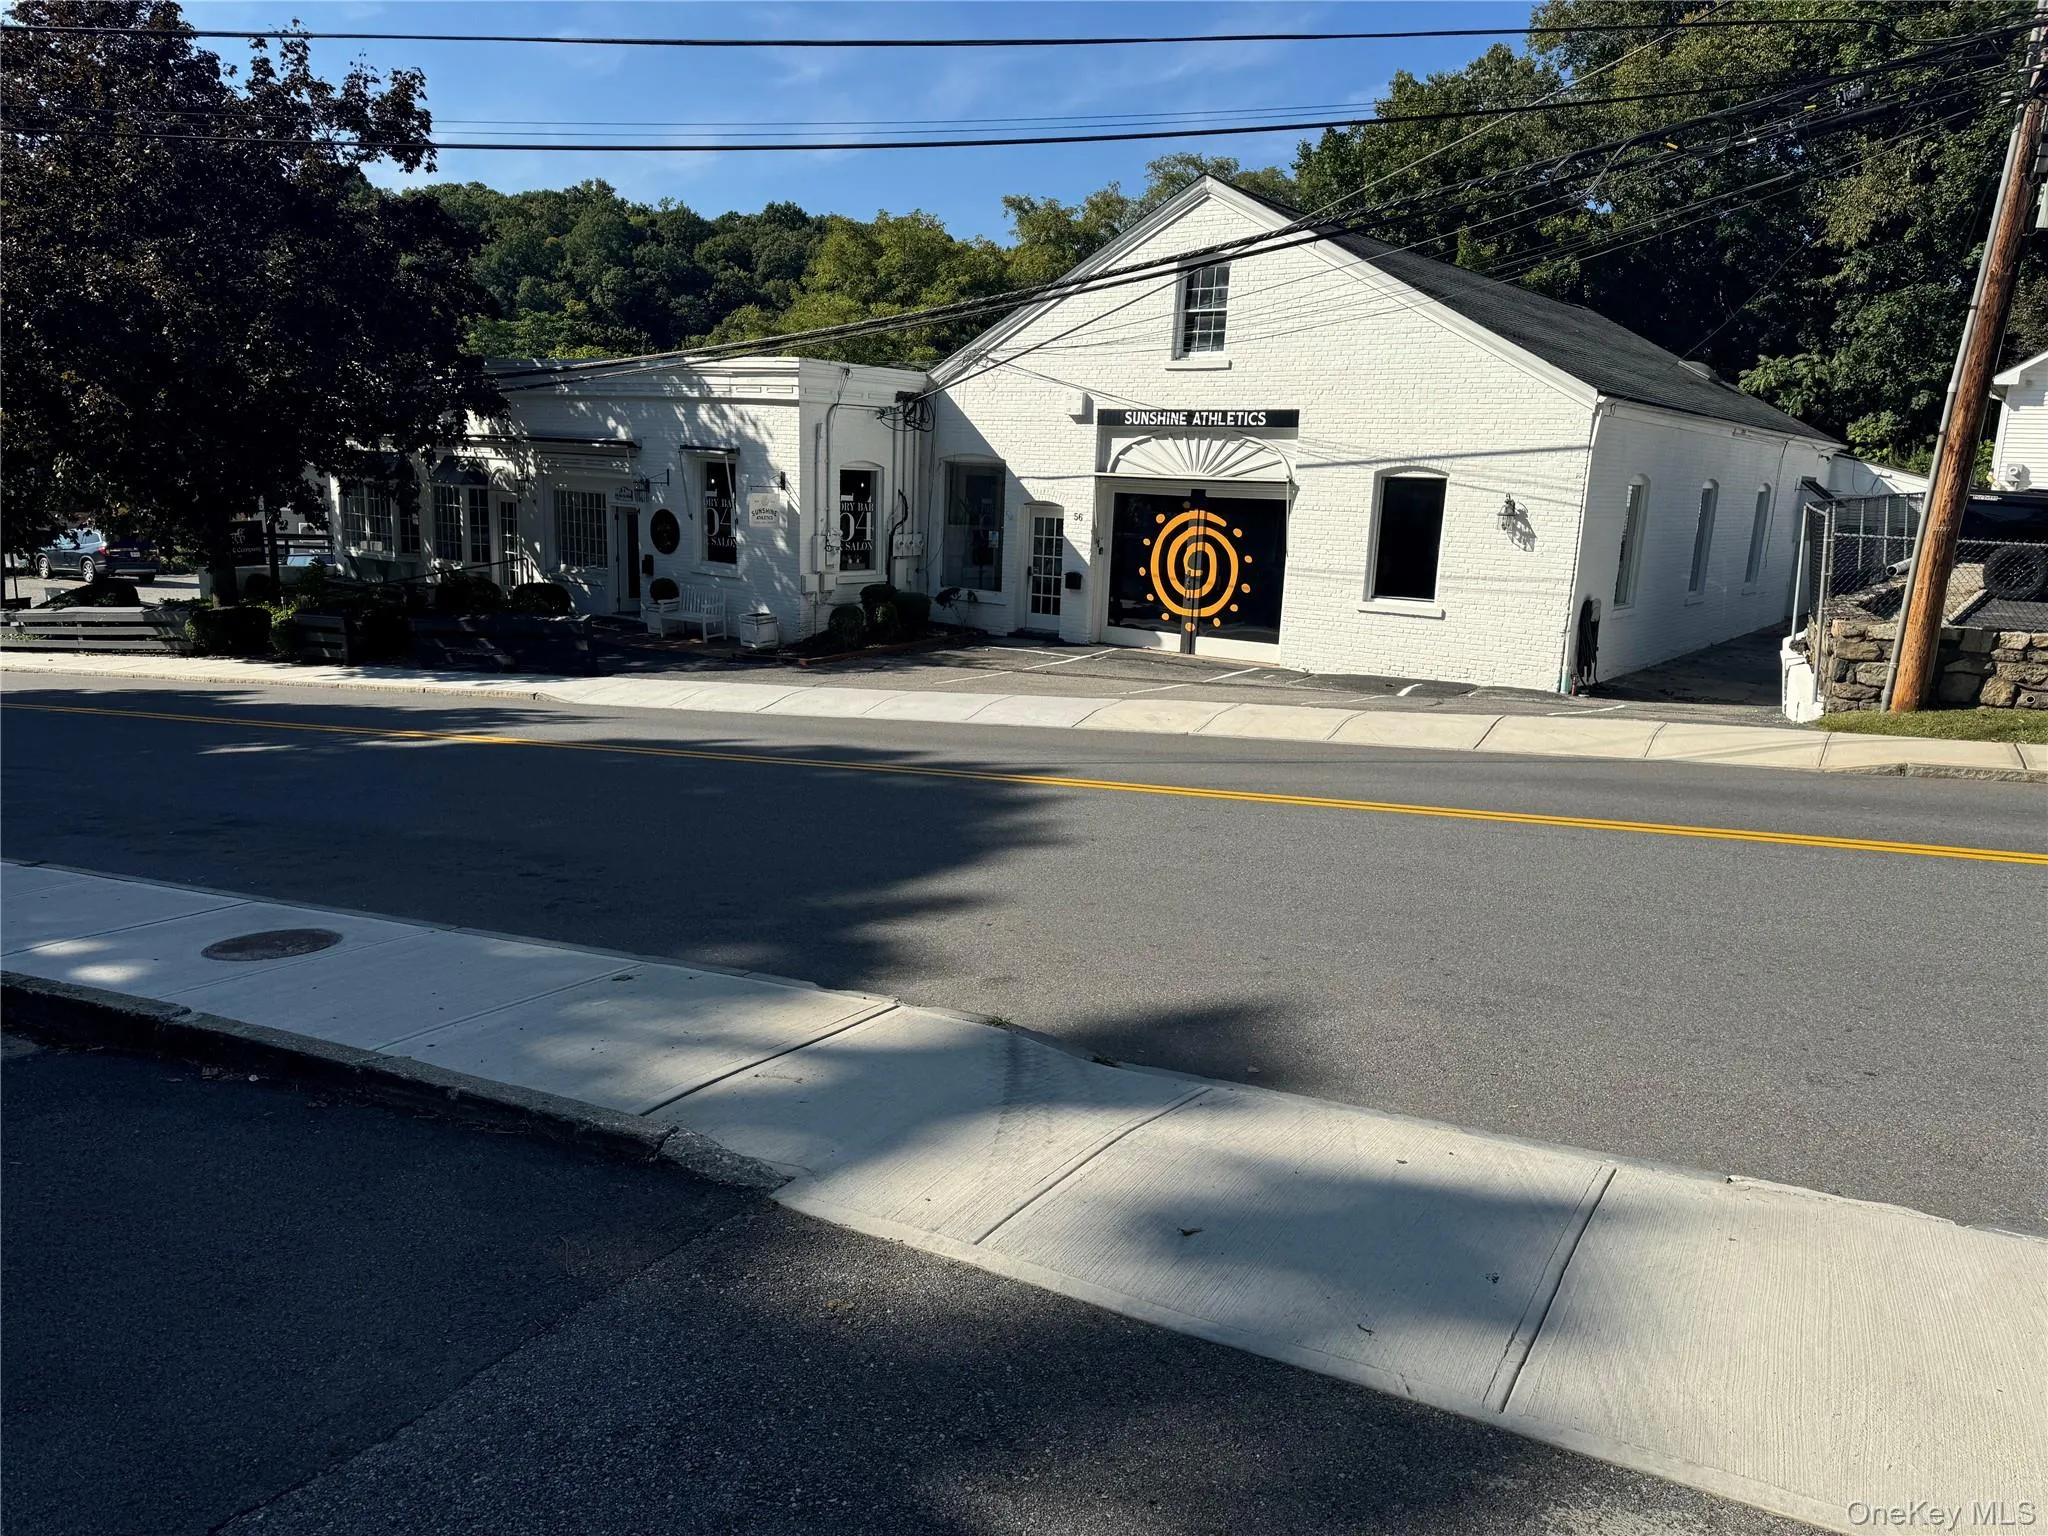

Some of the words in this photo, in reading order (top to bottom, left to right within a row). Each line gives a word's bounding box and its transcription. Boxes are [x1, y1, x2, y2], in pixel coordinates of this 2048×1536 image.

[1124, 411, 1188, 426] SUNSHINE
[1192, 411, 1267, 426] ATHLETICS
[857, 502, 874, 511] BAR
[751, 507, 777, 517] SUNSHINE
[1074, 513, 1083, 521] 56
[845, 542, 873, 551] SALON
